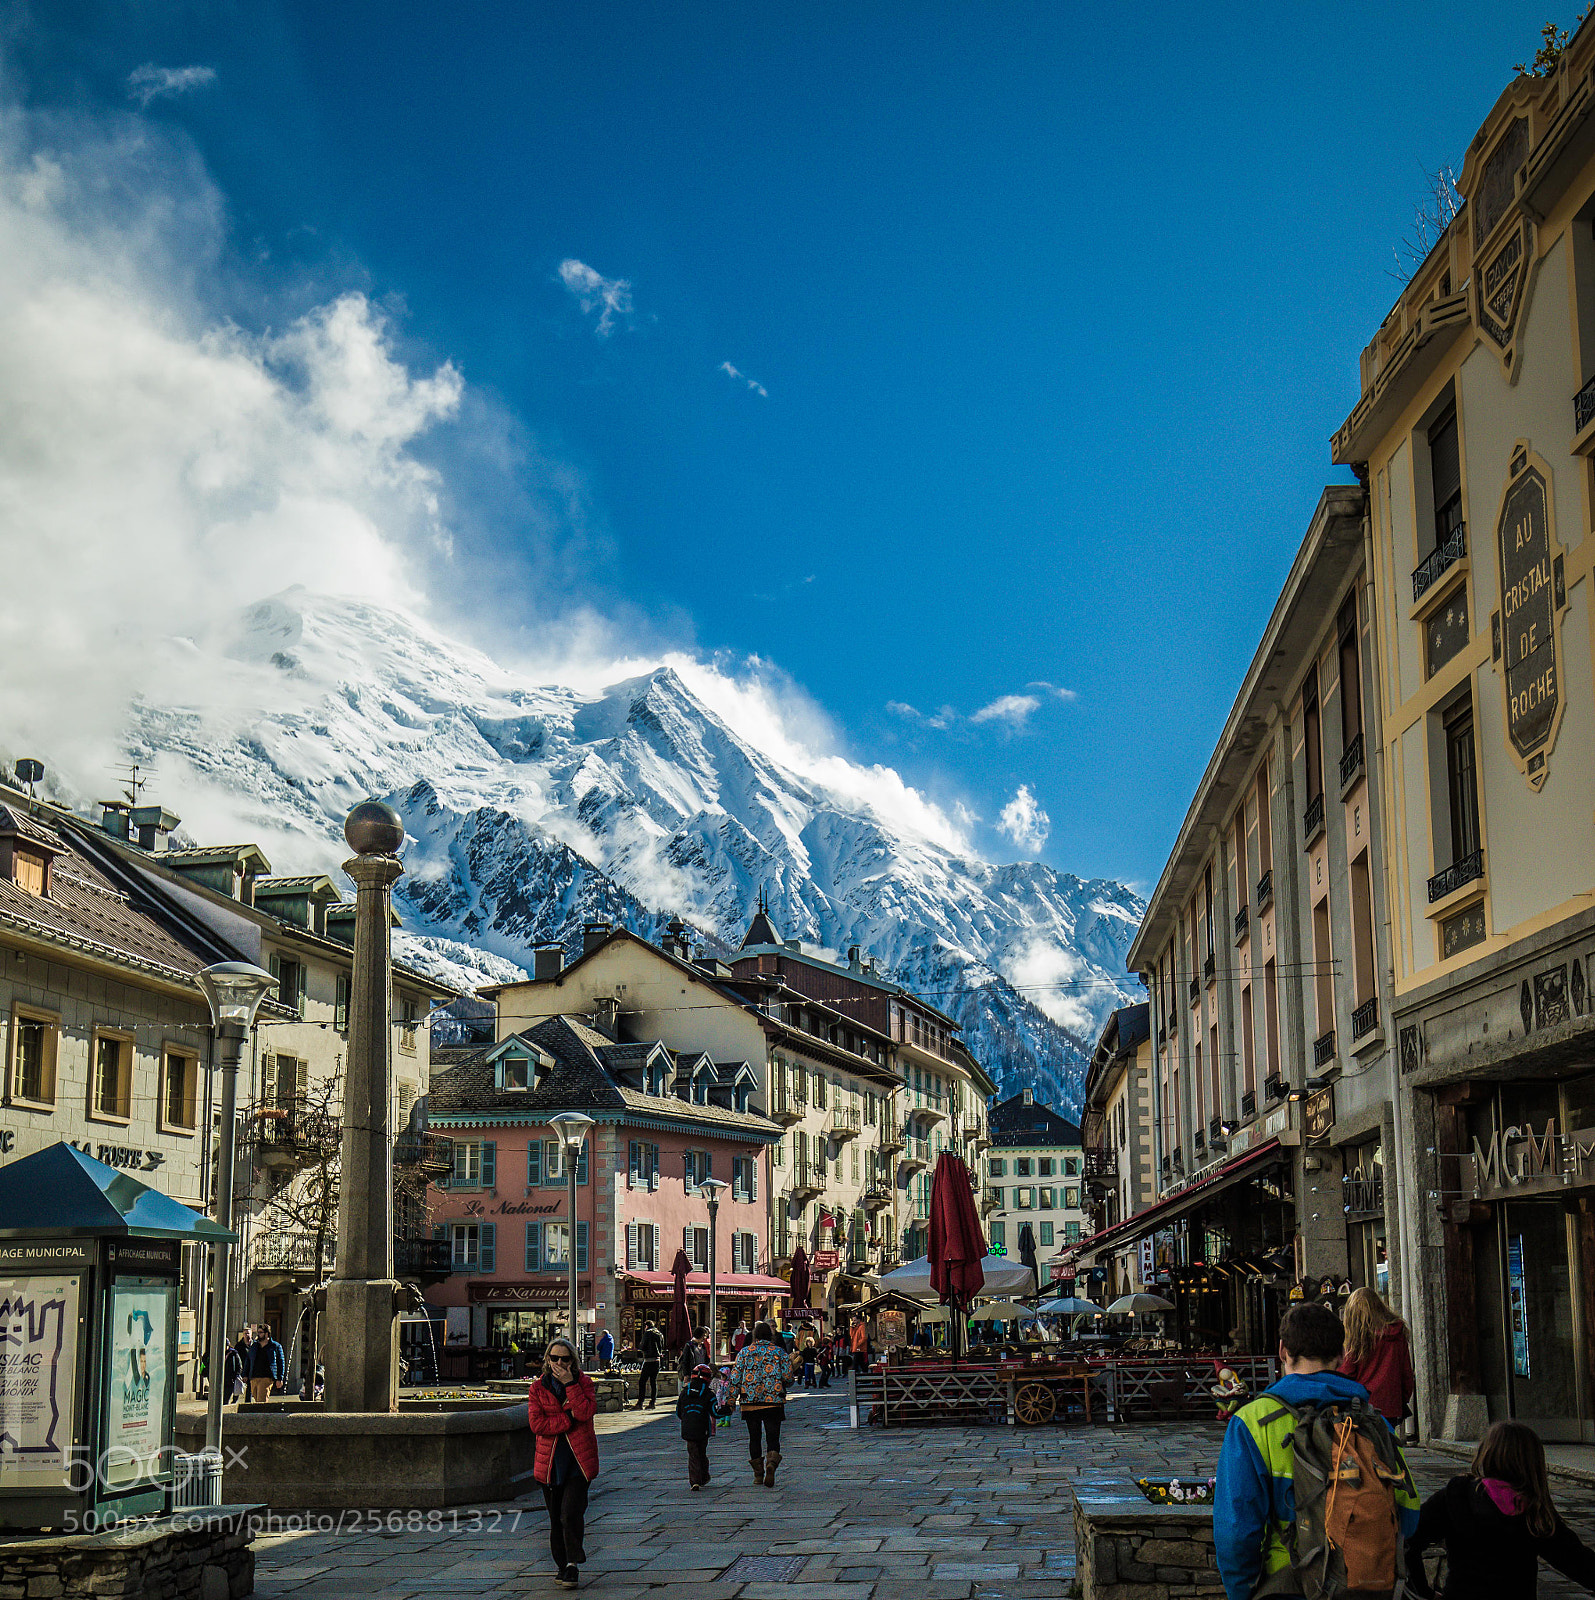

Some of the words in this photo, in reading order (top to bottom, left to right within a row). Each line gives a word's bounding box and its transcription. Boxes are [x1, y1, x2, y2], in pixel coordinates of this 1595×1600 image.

[1515, 512, 1532, 552] AU
[1505, 558, 1550, 618] CRISTAL
[1520, 622, 1537, 660] DE
[1511, 666, 1554, 724] ROCHE
[97, 1144, 142, 1169] POSTE
[1472, 1118, 1556, 1188] MGM
[464, 1200, 484, 1216] Le
[490, 1199, 561, 1215] National
[0, 1249, 23, 1258] AGE
[26, 1247, 86, 1258] MUNICIPAL
[118, 1248, 145, 1259] AFFICHAGE
[146, 1249, 171, 1261] MUNICIPAL
[1143, 1237, 1152, 1281] NEMA
[505, 1288, 570, 1299] National
[0, 1353, 42, 1366] SILAC
[12, 1378, 39, 1387] AVRIL
[124, 1388, 149, 1404] MAGIC
